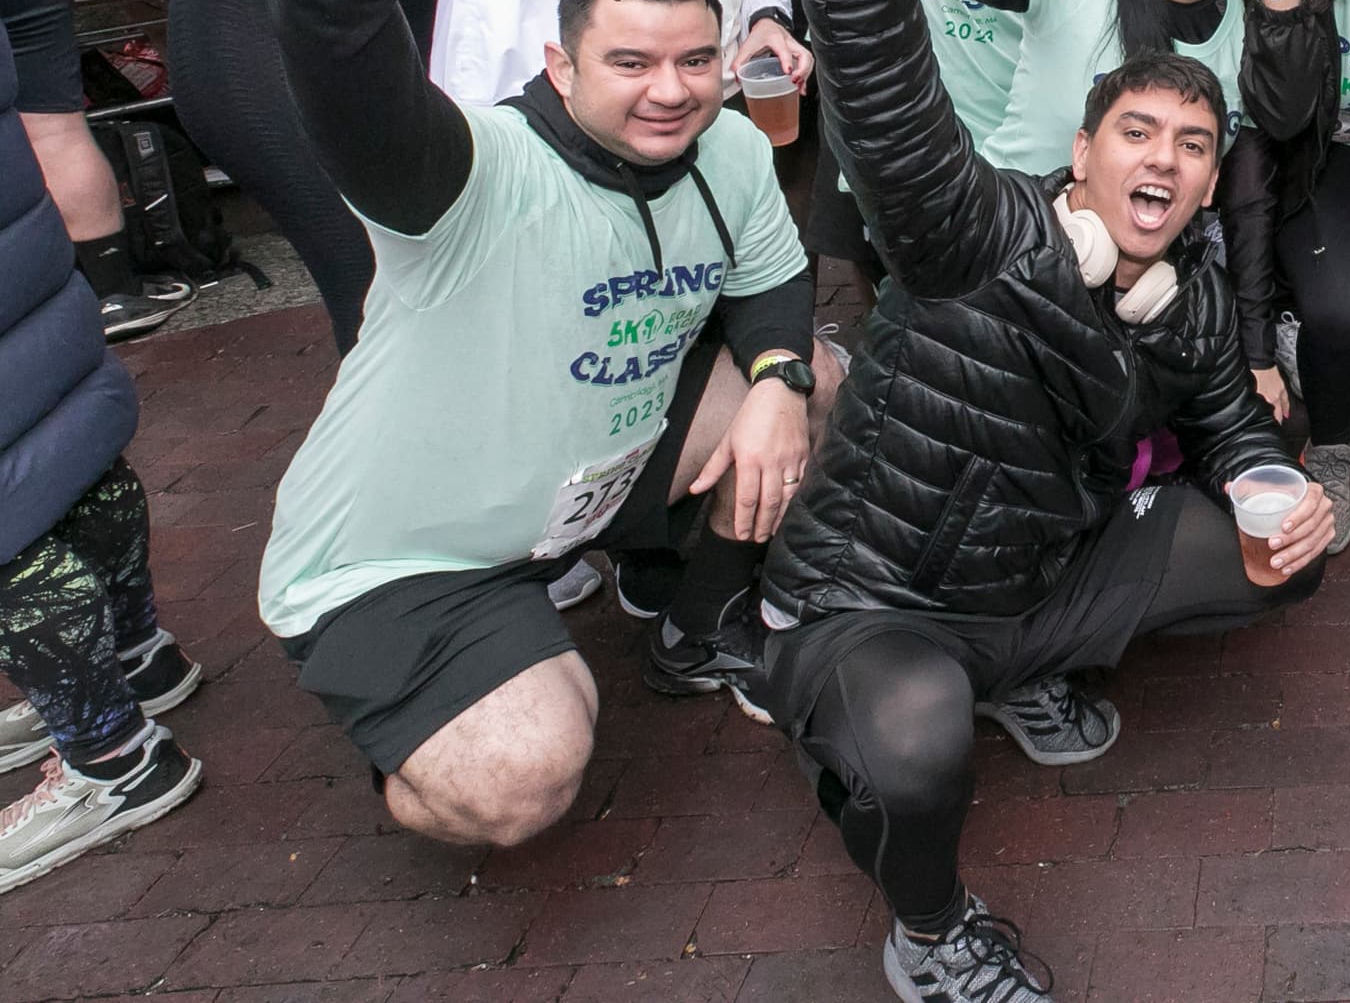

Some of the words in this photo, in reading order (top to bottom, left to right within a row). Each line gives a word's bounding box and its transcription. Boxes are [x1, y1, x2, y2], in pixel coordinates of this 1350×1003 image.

[583, 262, 723, 317] SPRING
[669, 304, 701, 324] ROAD
[570, 317, 707, 385] CLASSIC
[607, 319, 639, 347] 5K
[609, 391, 665, 436] 2023
[563, 460, 647, 525] 273
